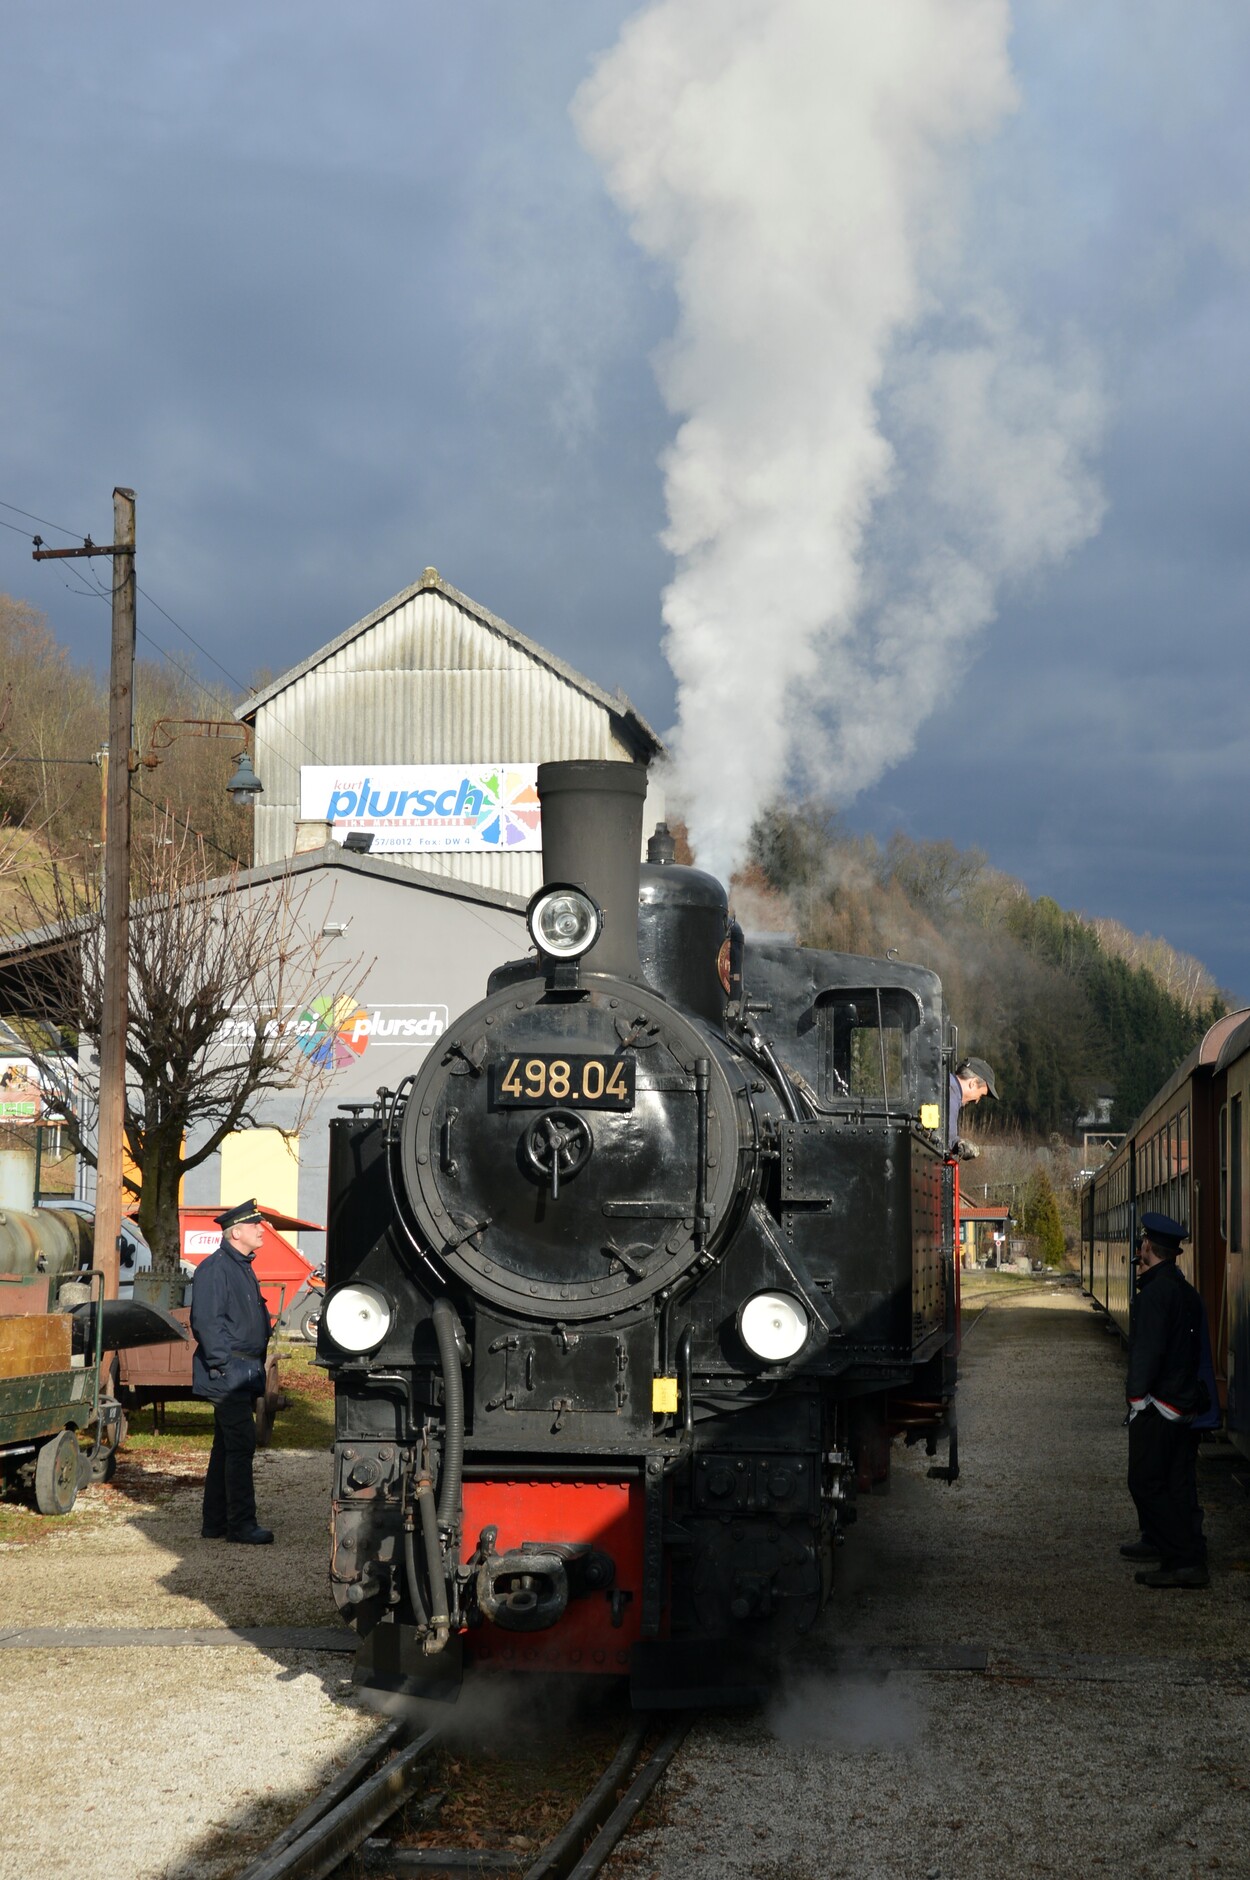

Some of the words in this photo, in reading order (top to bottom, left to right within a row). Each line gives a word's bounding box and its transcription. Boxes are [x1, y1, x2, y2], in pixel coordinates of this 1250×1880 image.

[333, 780, 363, 790] kurt
[326, 777, 484, 821] plursch
[445, 838, 461, 846] DW
[464, 837, 471, 845] 4
[352, 1010, 444, 1043] plursch
[501, 1058, 628, 1100] 498.04
[198, 1236, 223, 1245] STEIN
